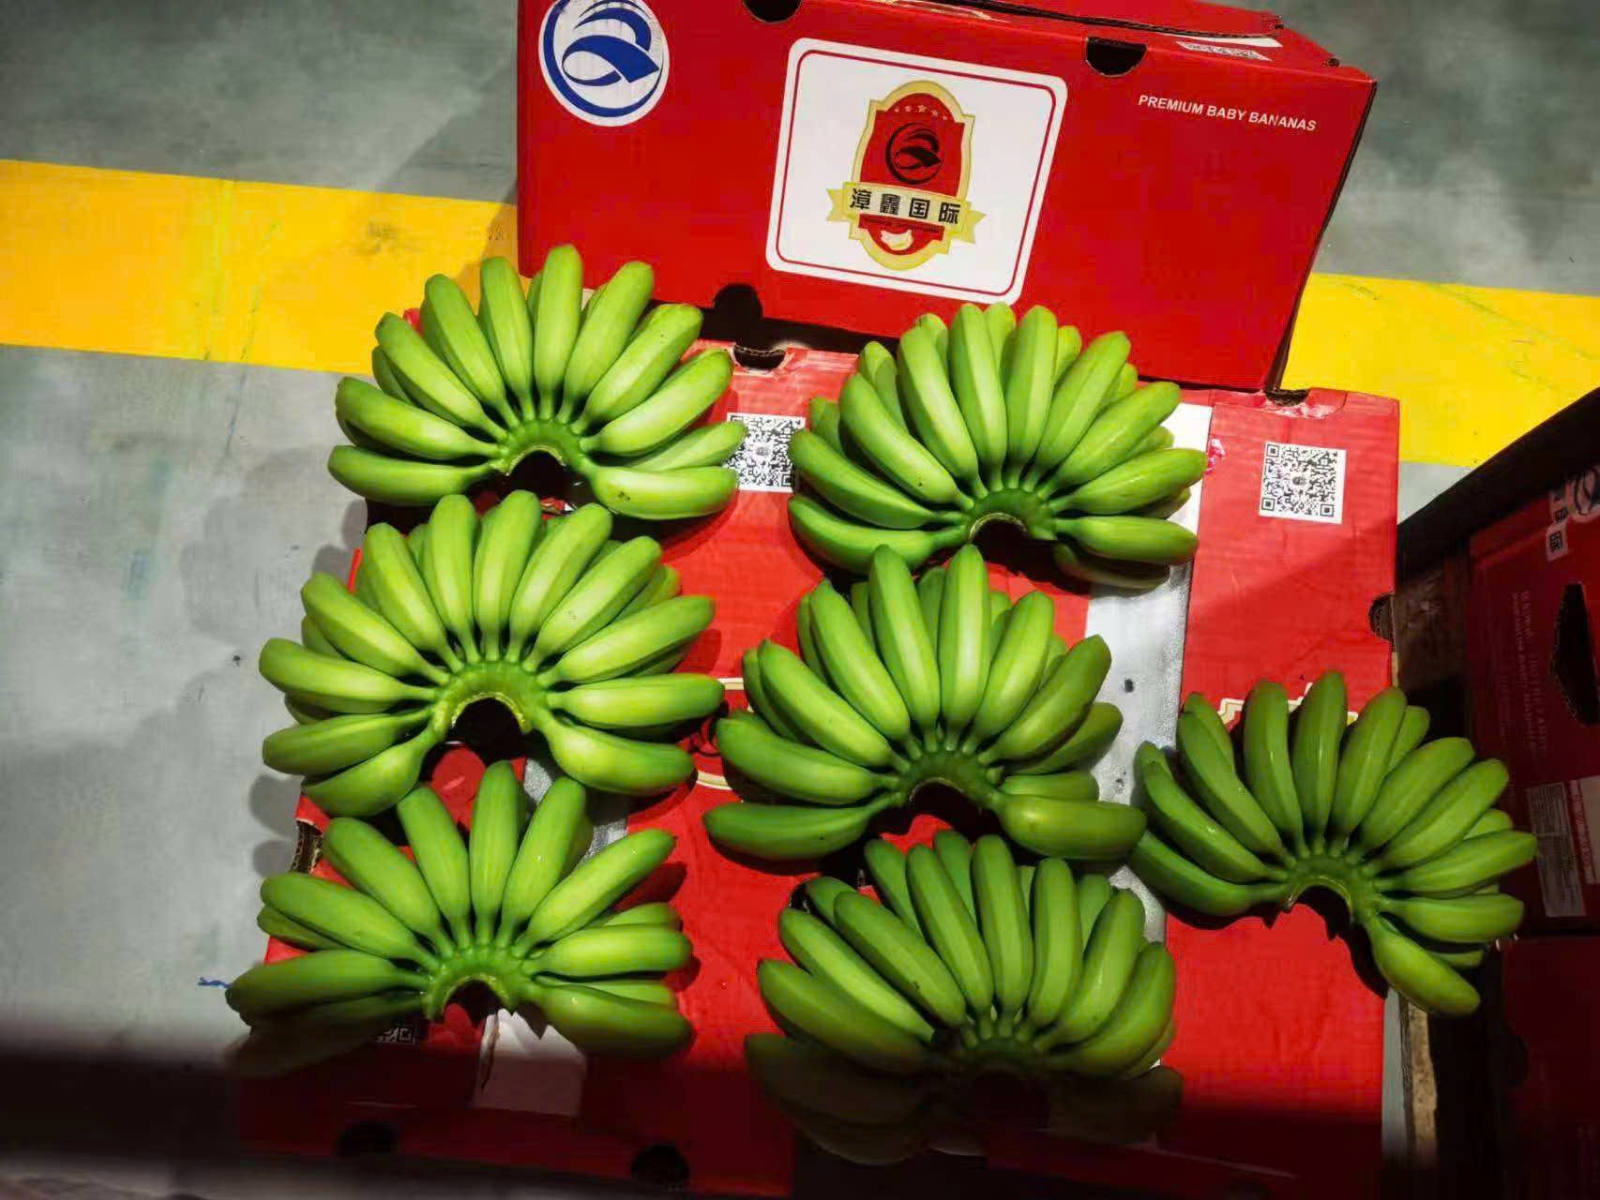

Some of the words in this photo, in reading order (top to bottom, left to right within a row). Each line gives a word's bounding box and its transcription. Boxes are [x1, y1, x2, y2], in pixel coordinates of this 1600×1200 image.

[1138, 94, 1203, 115] PREMIUM
[1207, 105, 1247, 121] BABY
[1249, 112, 1317, 131] BANANAS
[849, 188, 961, 225] 漳鑫国际
